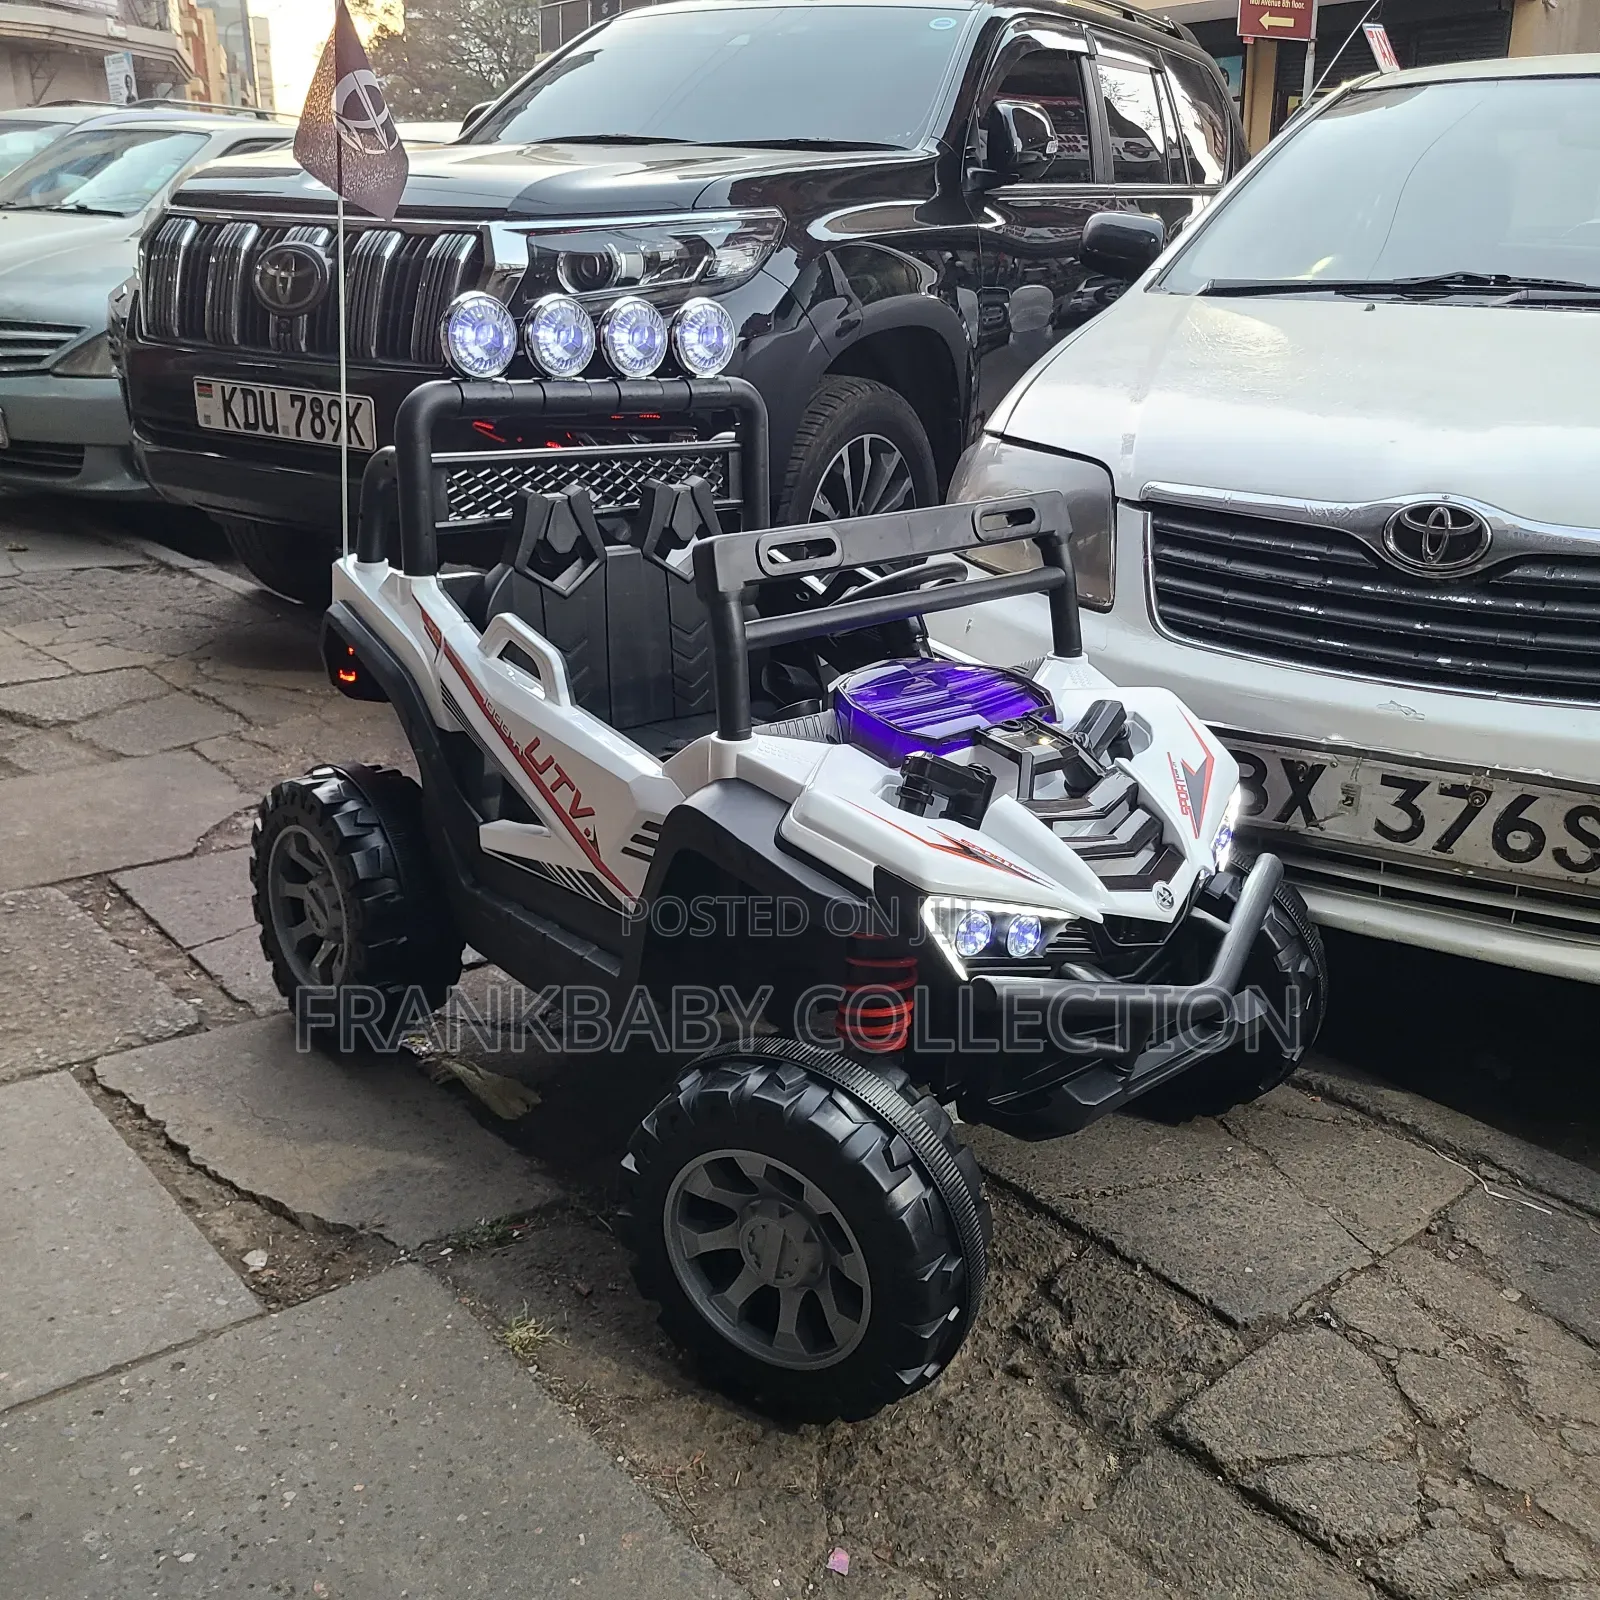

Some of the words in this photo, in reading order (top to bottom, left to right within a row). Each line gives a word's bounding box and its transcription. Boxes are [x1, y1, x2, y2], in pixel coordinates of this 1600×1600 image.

[220, 385, 279, 435] KDU
[290, 394, 366, 447] 789K
[524, 736, 596, 819] UTV
[1373, 773, 1600, 874] 376S
